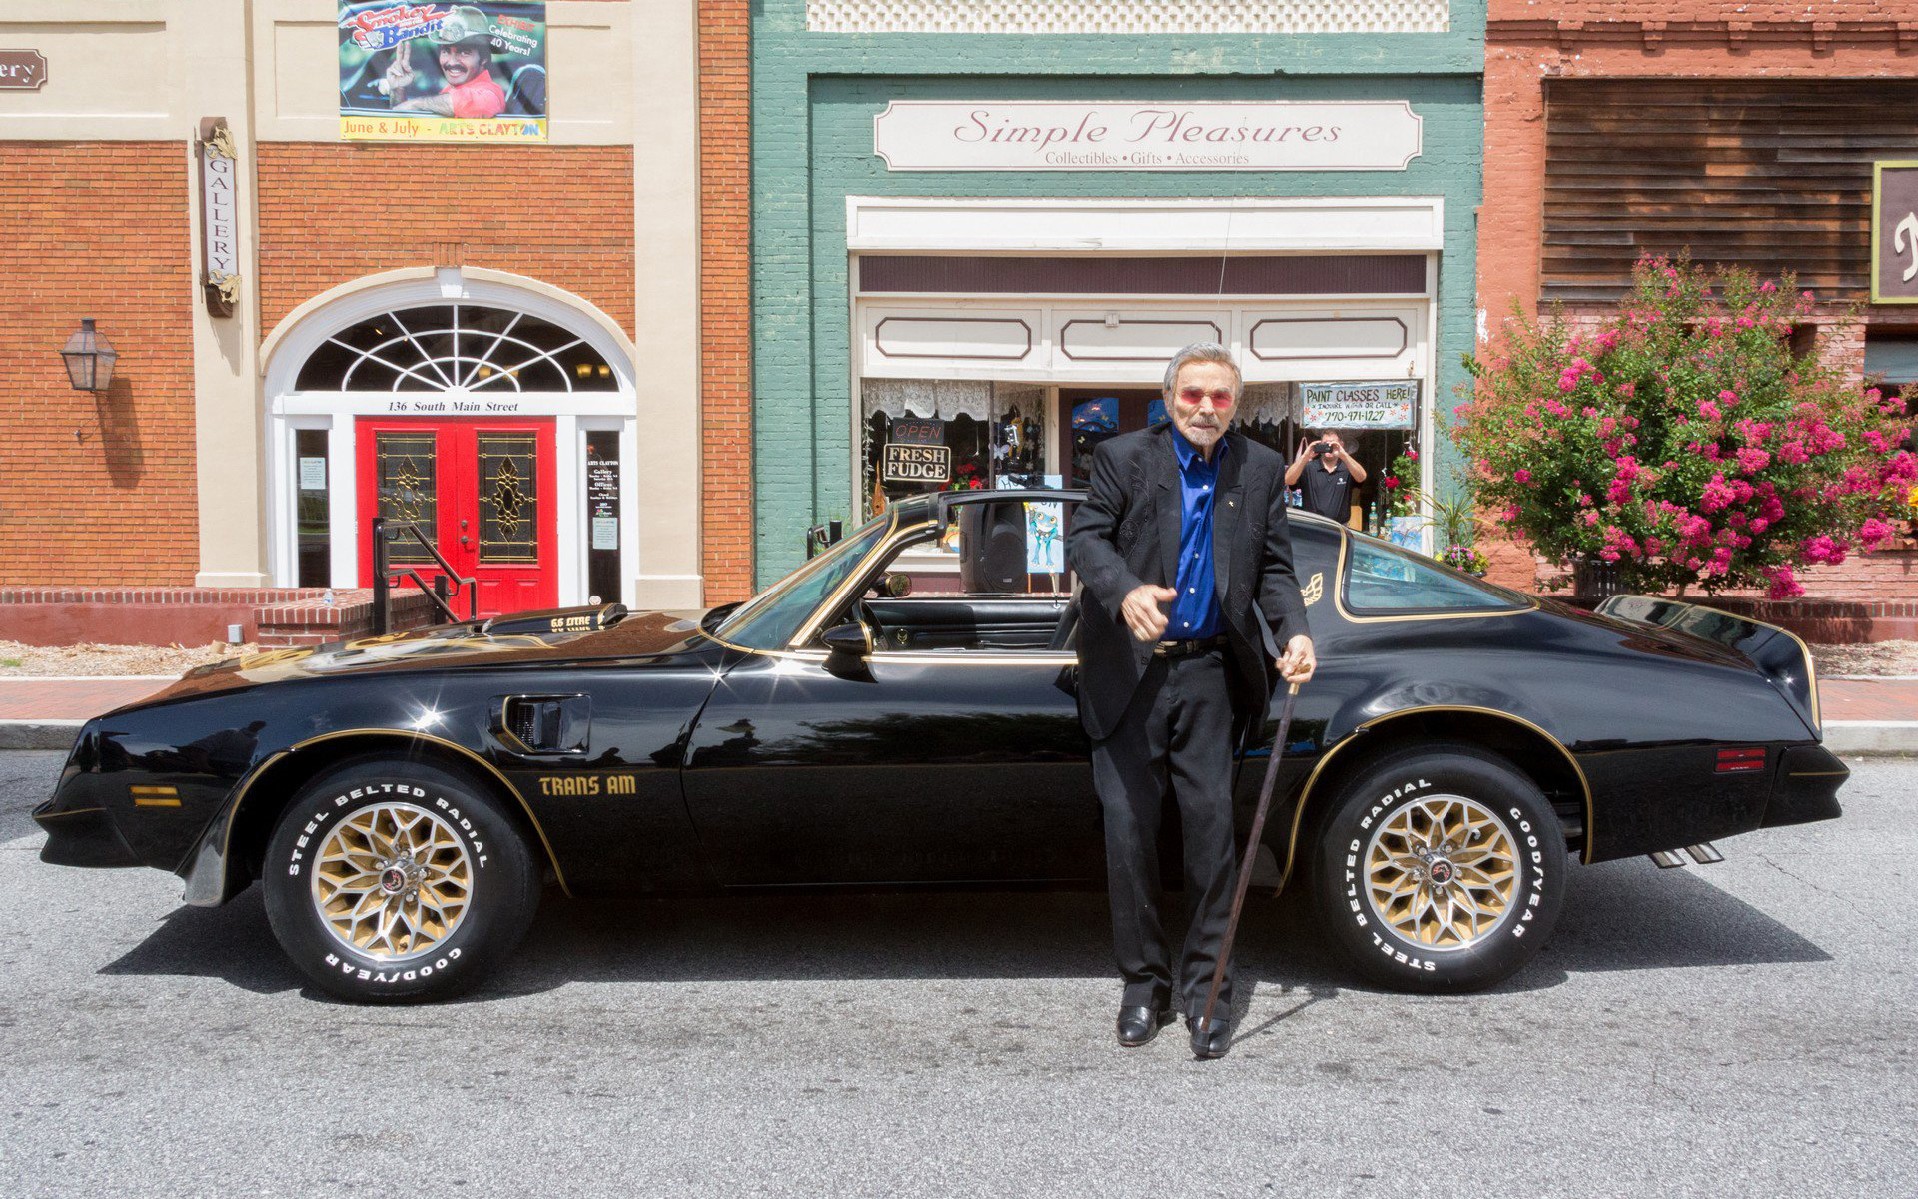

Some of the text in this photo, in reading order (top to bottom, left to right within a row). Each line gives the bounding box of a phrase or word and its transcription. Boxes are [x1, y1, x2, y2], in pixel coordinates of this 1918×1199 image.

[345, 5, 453, 40] Smokey
[497, 14, 536, 32] EXHIBIT
[366, 20, 443, 49] Bandit
[489, 24, 538, 49] Celebrating
[490, 38, 531, 56] 40 Years!
[344, 121, 374, 134] June
[379, 121, 388, 134] &
[392, 121, 419, 137] July
[439, 123, 475, 136] ARTS
[479, 122, 540, 136] CLAYTON
[954, 109, 1342, 153] Simple Pleasures
[1045, 151, 1249, 165] Collectibles Gifts Accessories
[209, 159, 232, 270] GALLERY
[1306, 387, 1410, 404] PAINT CLASSES HERE!
[389, 401, 519, 412] 136 South Main Street
[1375, 402, 1393, 410] CALL
[895, 425, 942, 440] OPEN
[888, 447, 946, 464] FRESH
[887, 461, 946, 479] FUDGE
[551, 615, 591, 628] 6.6 LITRE
[538, 774, 637, 796] TRANS AM
[289, 784, 488, 876] STEEL BELTED RADIAL
[1346, 779, 1437, 971] STEEL BELTED RADIAL
[1509, 806, 1545, 938] GOODYEAR
[325, 947, 462, 984] GOODYEAR
